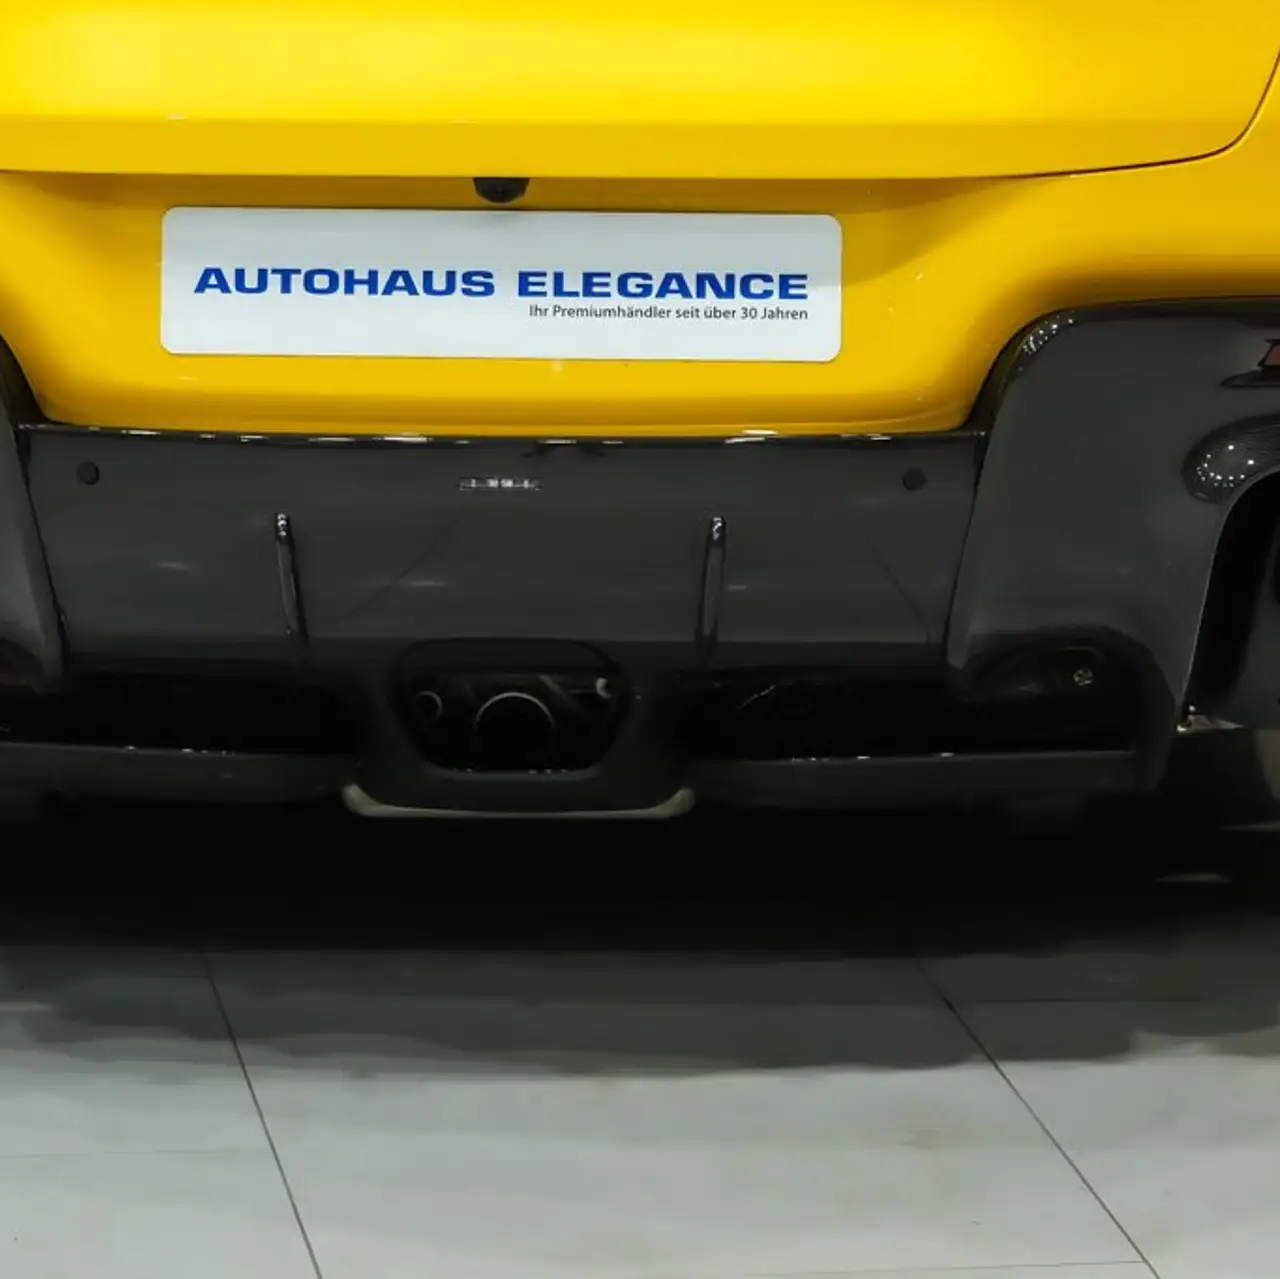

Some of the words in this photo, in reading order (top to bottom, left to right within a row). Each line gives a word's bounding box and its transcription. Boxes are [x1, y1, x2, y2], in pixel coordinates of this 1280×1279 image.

[194, 267, 494, 297] AUTOHAUS
[518, 271, 808, 300] ELEGANCE
[529, 305, 549, 317] Ihr
[552, 305, 672, 319] Premiumhändler
[675, 307, 700, 320] seit
[703, 306, 737, 320] über
[740, 306, 758, 320] 30
[760, 307, 808, 321] Jahren
